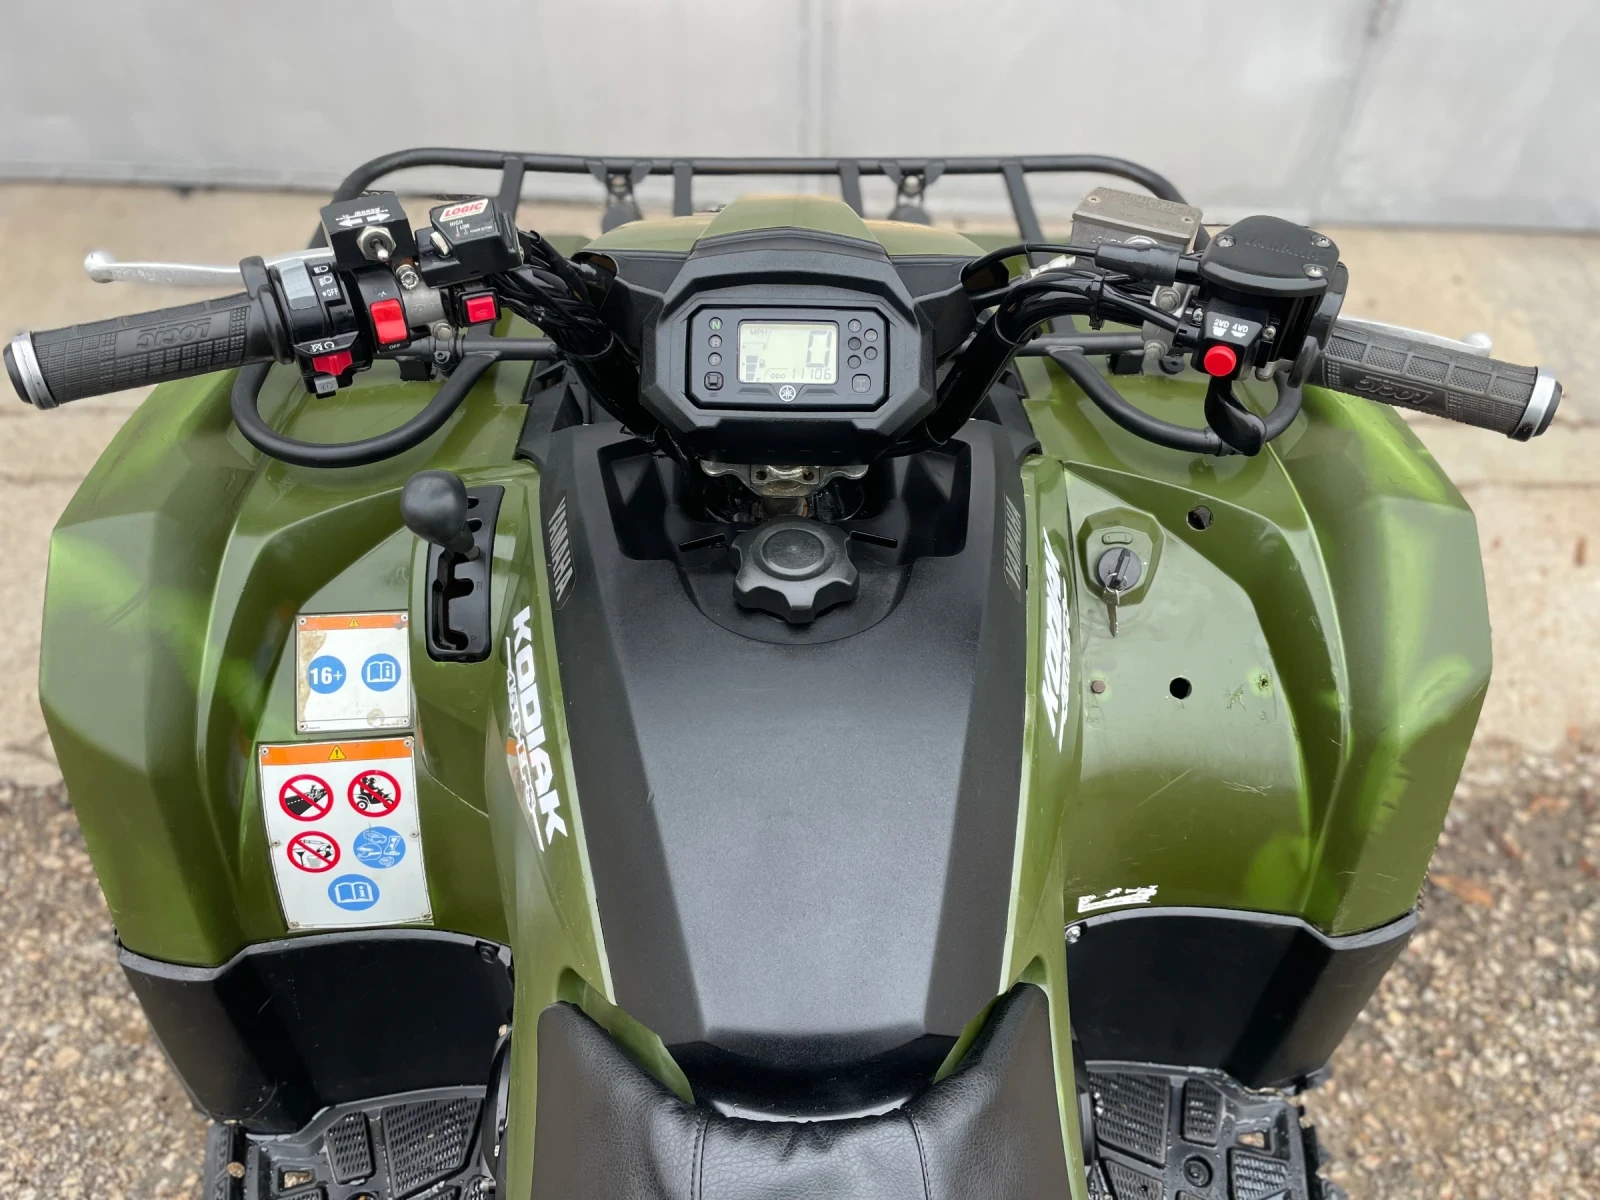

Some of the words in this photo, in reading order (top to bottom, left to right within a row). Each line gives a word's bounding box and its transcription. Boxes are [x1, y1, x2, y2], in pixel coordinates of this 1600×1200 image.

[444, 202, 484, 217] LOGIC
[326, 287, 338, 296] OFF
[712, 320, 721, 330] N
[749, 328, 768, 336] MPH
[1213, 318, 1230, 328] 2WD
[1231, 323, 1249, 333] 4WD
[137, 320, 211, 350] LOGIC
[712, 338, 720, 348] R
[806, 330, 832, 368] 0
[712, 356, 720, 365] P
[792, 368, 832, 380] 11106
[548, 496, 574, 602] YAMAHA
[1005, 494, 1022, 590] YAMAHA
[309, 667, 344, 685] 16+
[513, 606, 568, 845] KODIAK
